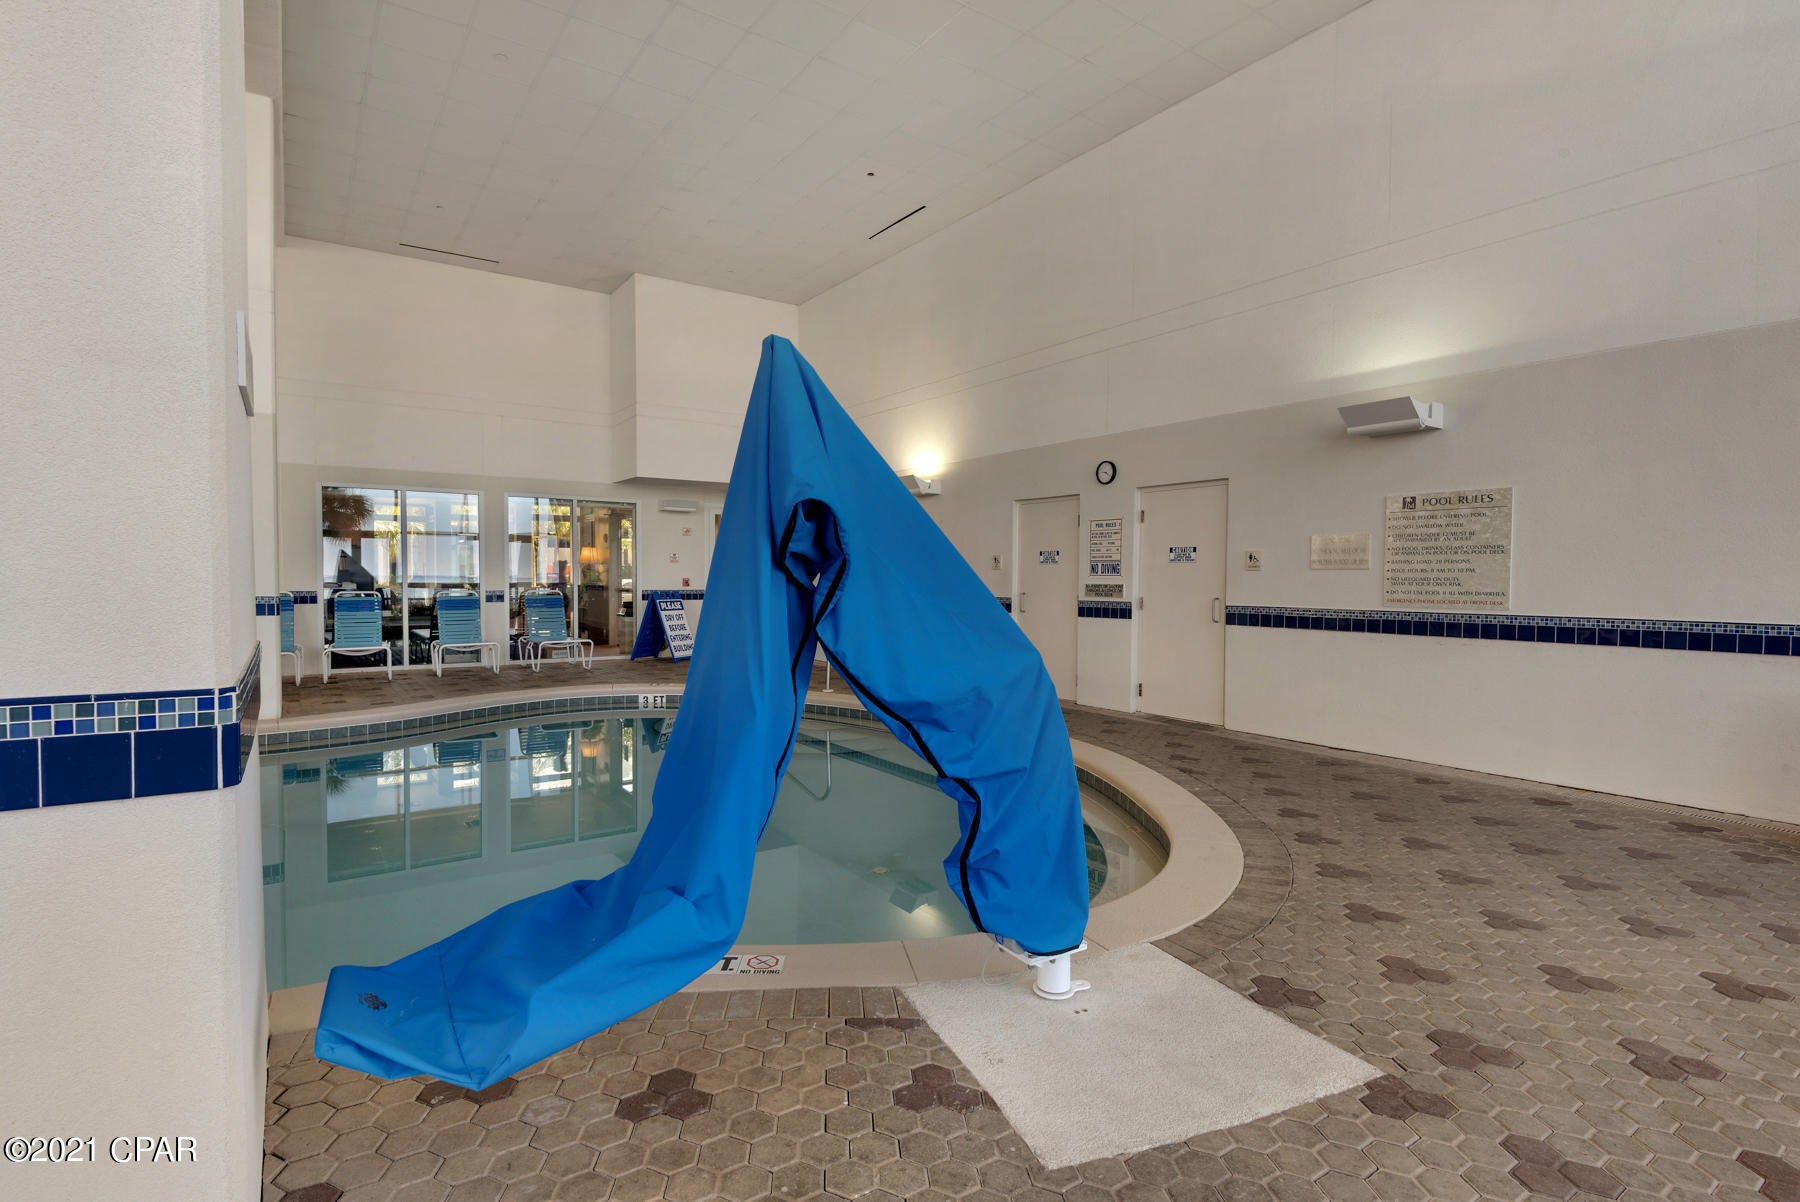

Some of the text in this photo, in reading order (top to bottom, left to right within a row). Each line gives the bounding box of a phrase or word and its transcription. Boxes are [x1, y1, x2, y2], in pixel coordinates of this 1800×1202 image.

[1422, 493, 1494, 506] POOL RULES
[1090, 563, 1120, 574] NO DIVING
[660, 601, 682, 610] PLEASE
[670, 633, 692, 642] ENTERING
[643, 696, 648, 706] 3
